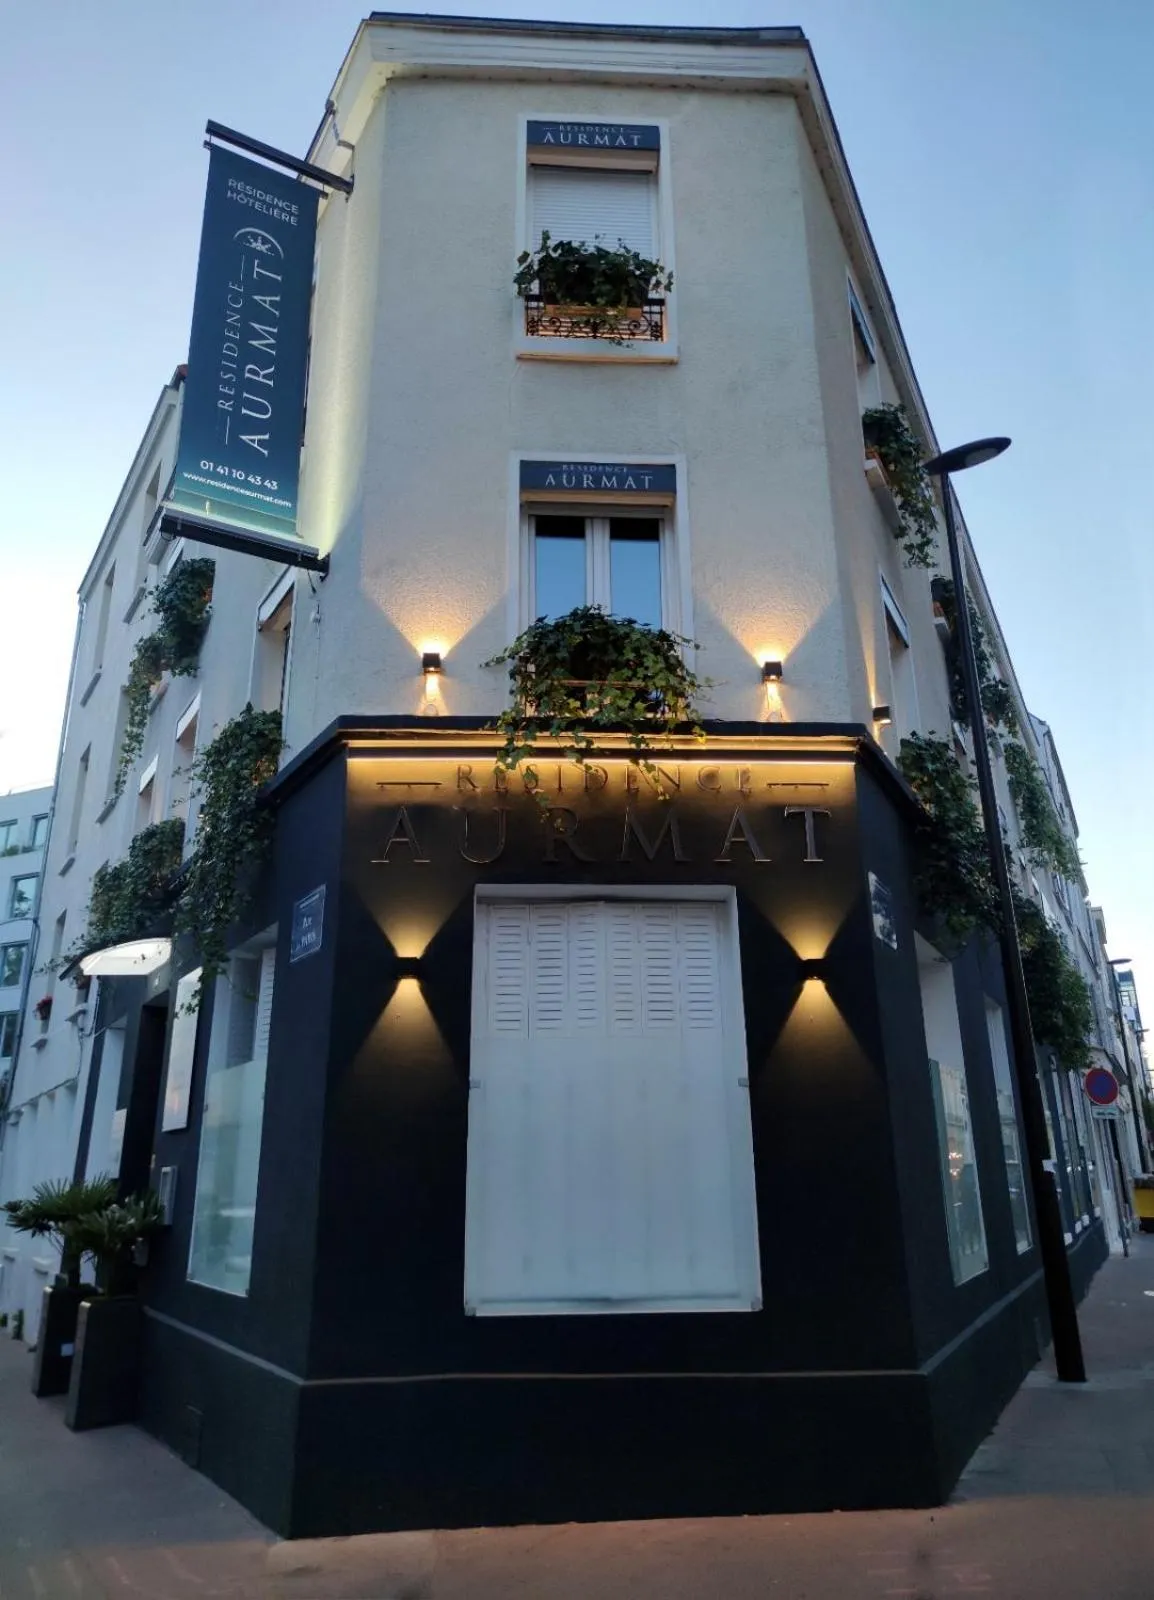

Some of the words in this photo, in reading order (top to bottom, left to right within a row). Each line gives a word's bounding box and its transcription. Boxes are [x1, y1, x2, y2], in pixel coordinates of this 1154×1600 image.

[543, 132, 641, 146] AURMAT
[227, 190, 298, 226] HÔTELIÈRE
[228, 179, 299, 214] RÉSIDENCE
[217, 281, 244, 411] RESIDENCE
[239, 259, 283, 458] AURMAT
[200, 460, 214, 472] 01
[217, 465, 229, 476] 41
[232, 469, 245, 480] 10
[247, 474, 262, 486] 43
[264, 479, 278, 491] 43
[545, 473, 653, 489] AURMAT
[370, 804, 833, 864] AURMAT
